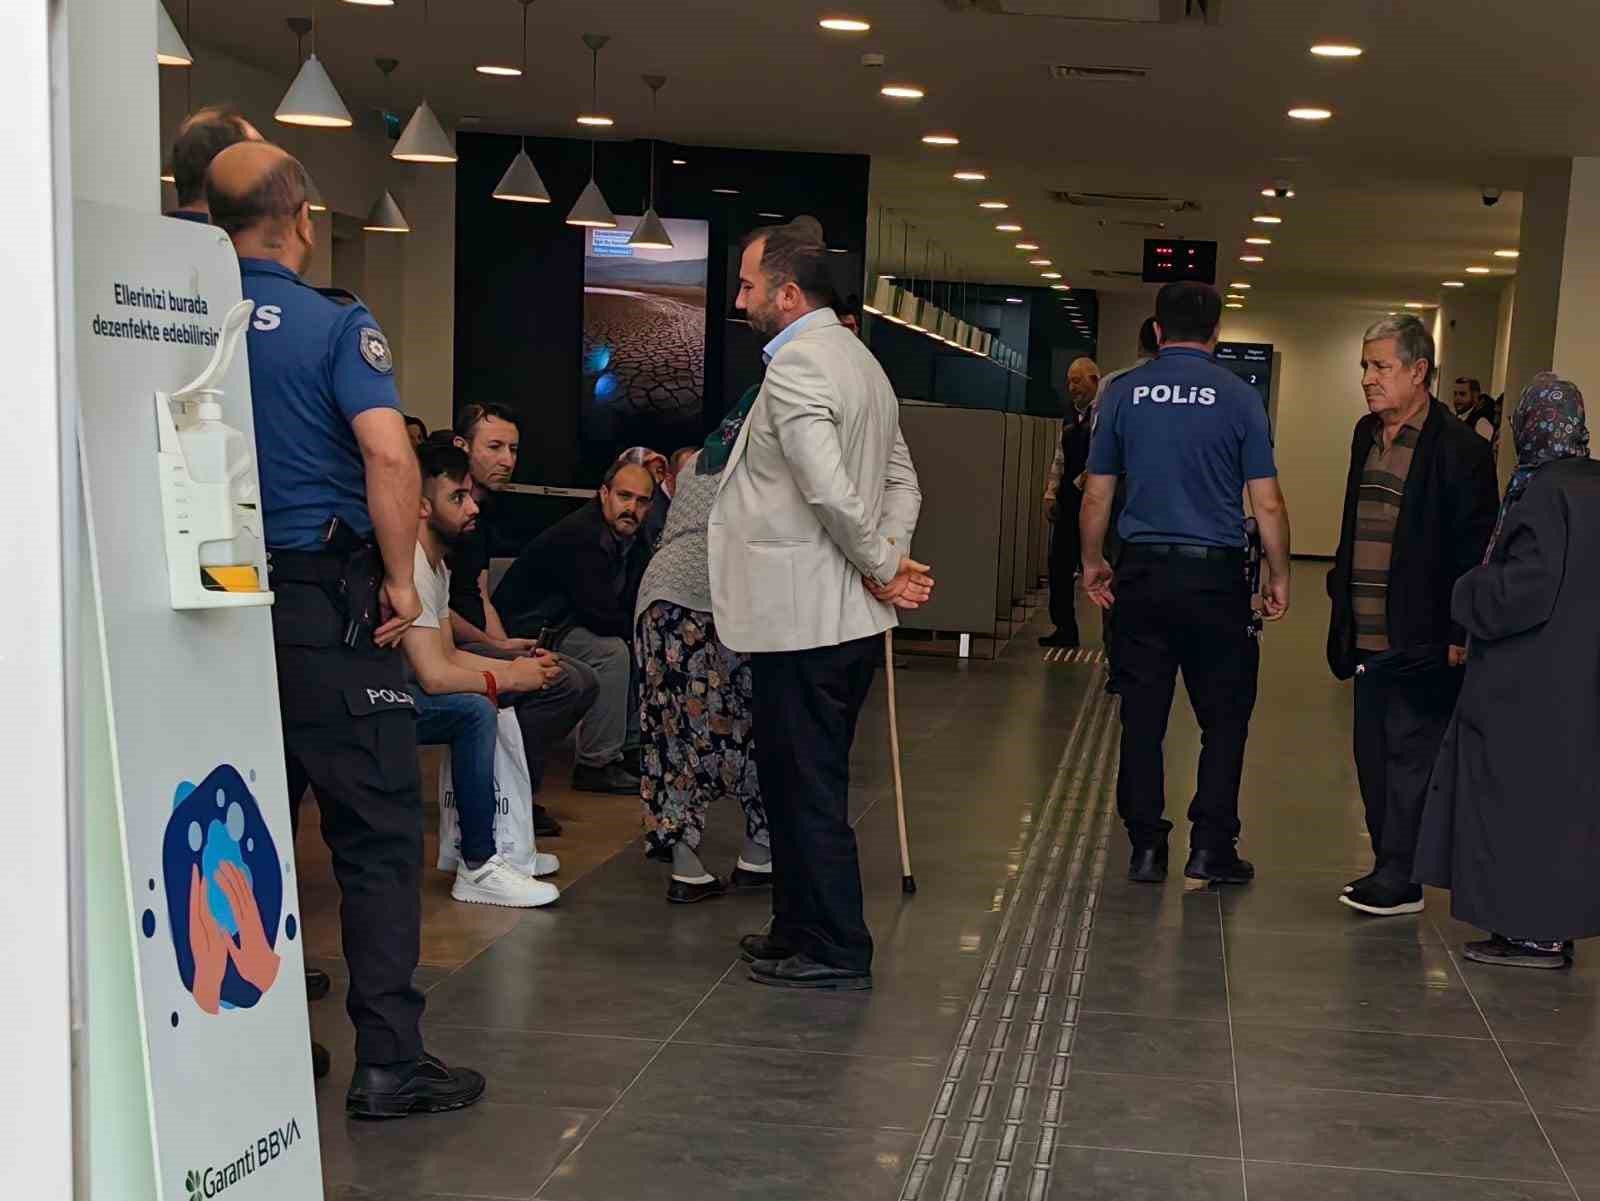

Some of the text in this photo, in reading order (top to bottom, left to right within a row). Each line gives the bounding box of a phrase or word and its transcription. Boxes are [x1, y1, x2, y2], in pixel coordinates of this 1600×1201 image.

[114, 283, 208, 315] Ellerinizi burada
[93, 314, 222, 348] dezenfekte edebilirsin
[203, 1117, 302, 1199] Garanti BBVA
